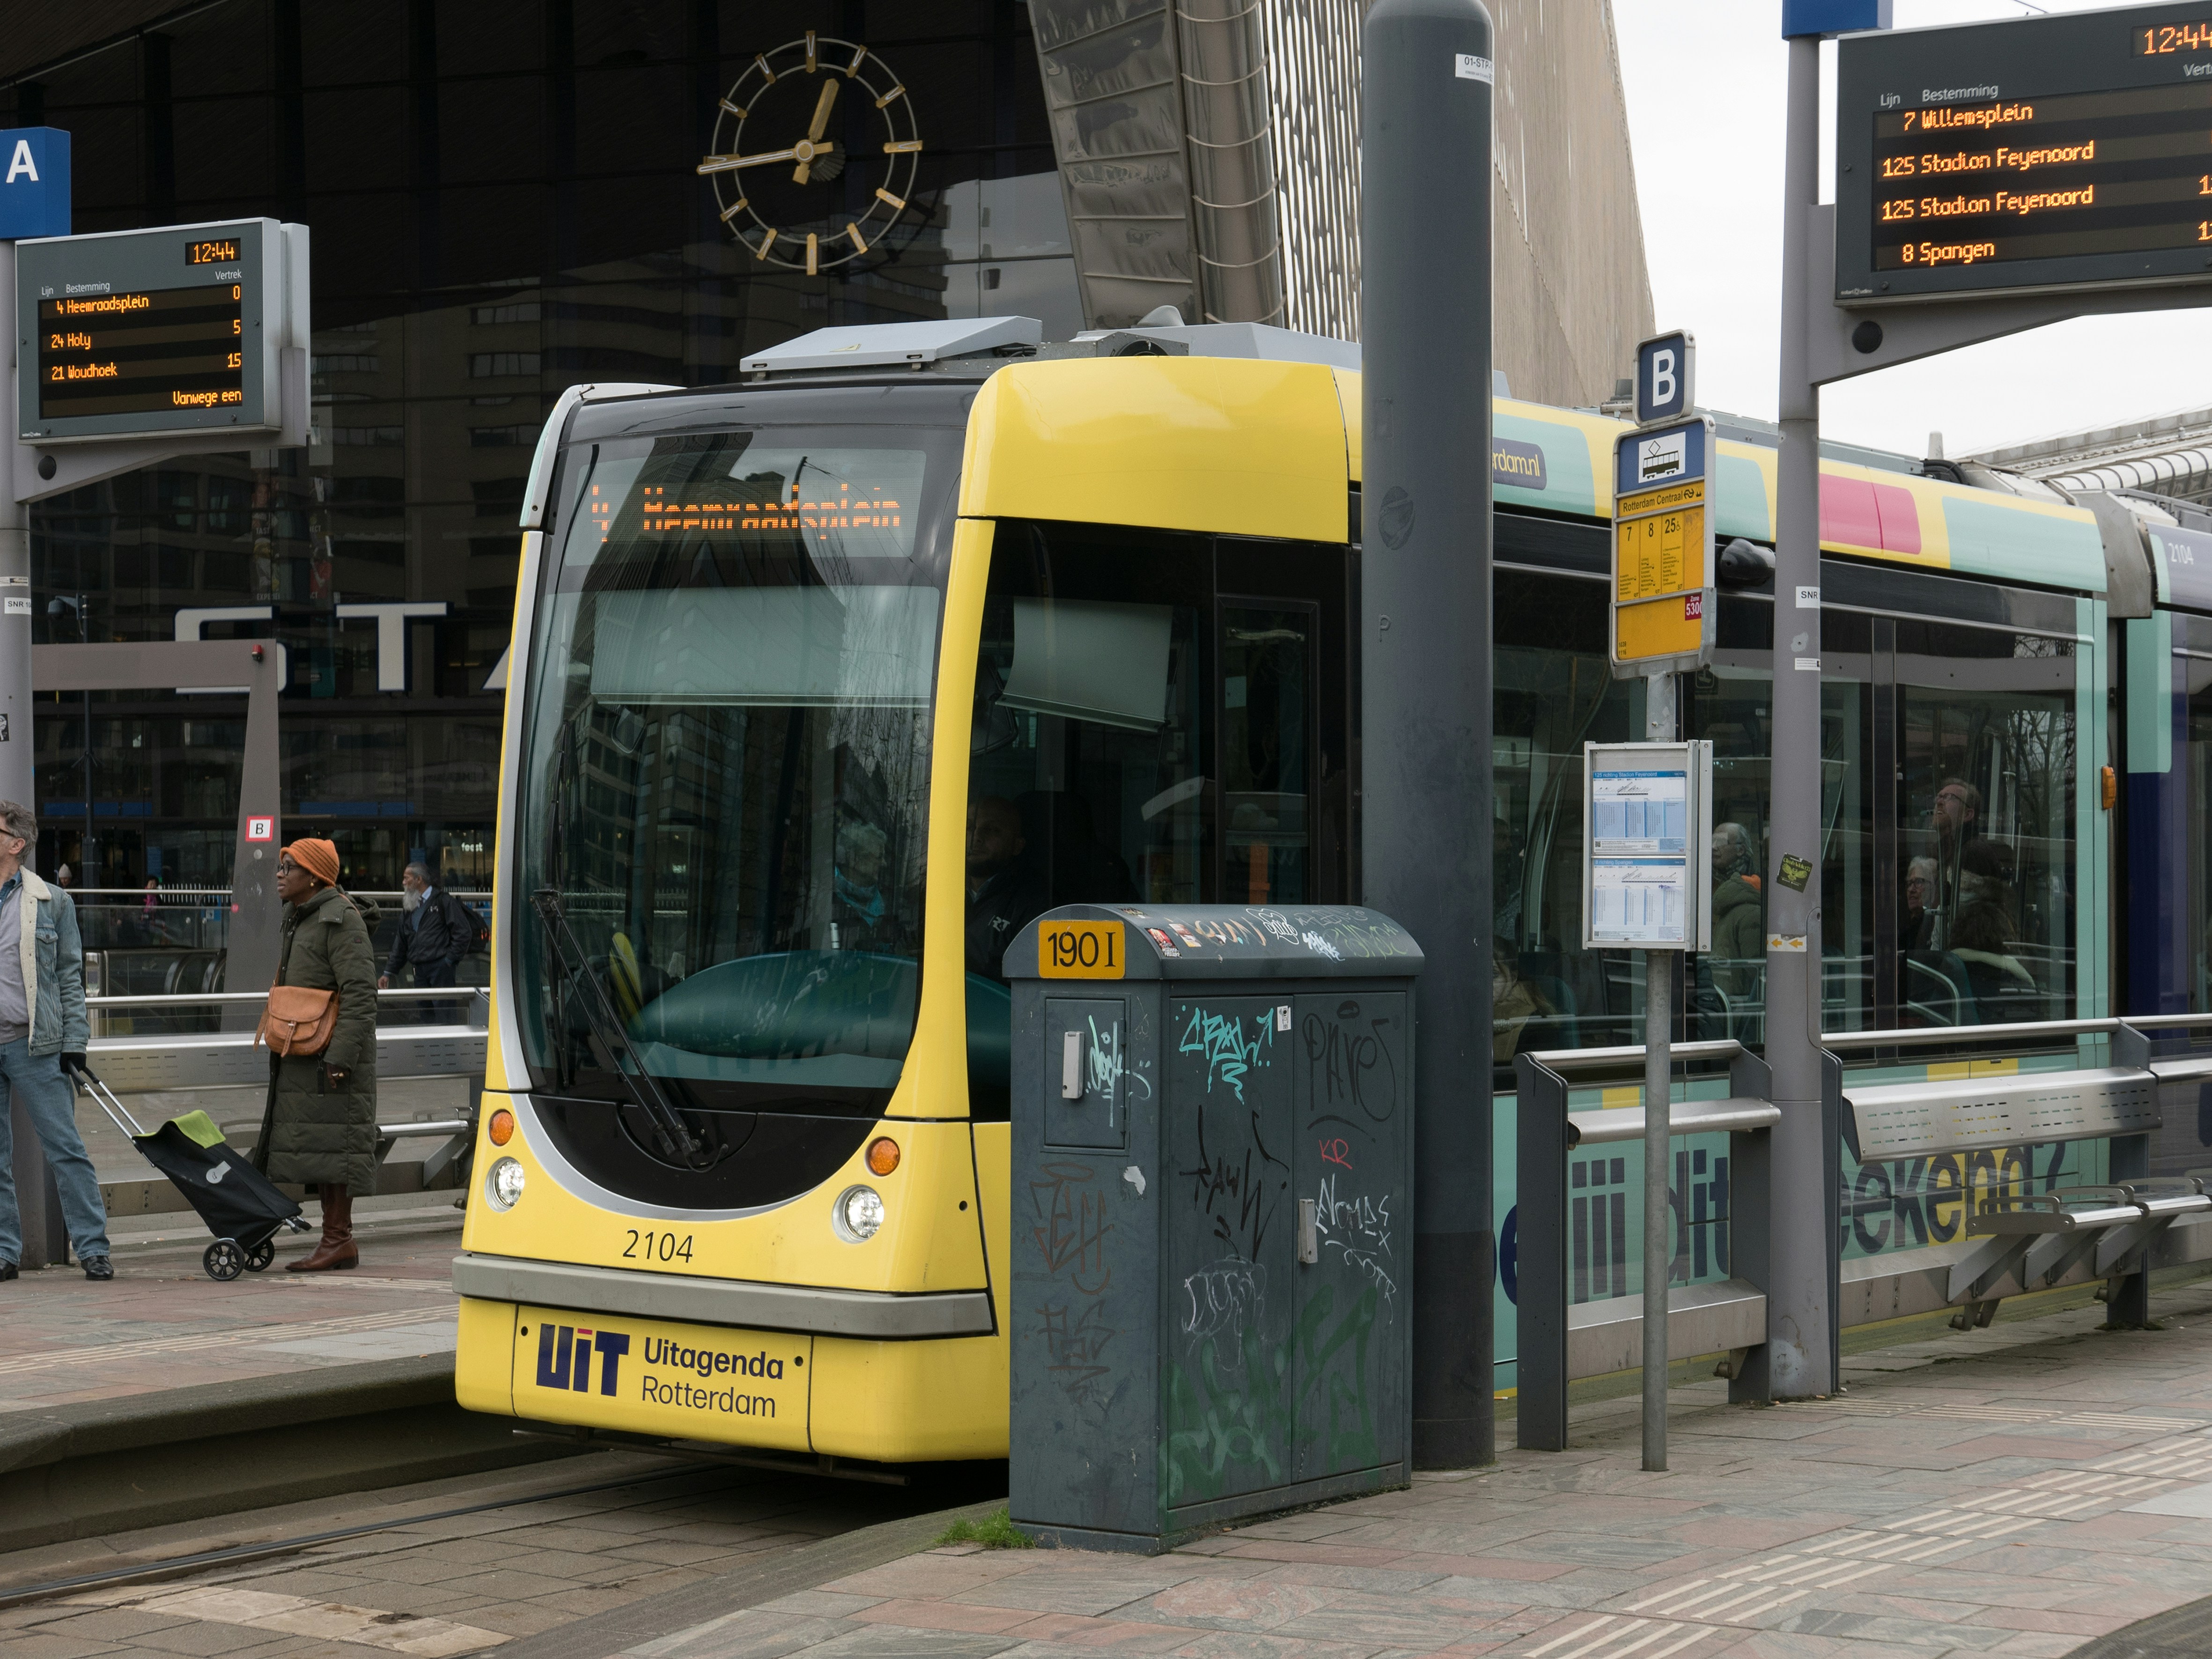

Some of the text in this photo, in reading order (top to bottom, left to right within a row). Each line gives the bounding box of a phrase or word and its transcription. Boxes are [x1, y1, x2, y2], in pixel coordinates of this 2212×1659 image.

[2144, 23, 2212, 55] 12:44
[1880, 84, 1998, 108] Lijn Bestemming
[1904, 104, 2033, 131] 7 Willemsplein
[6, 140, 39, 184] A
[1883, 140, 2094, 177] 125 Stadion Feyenoord
[1882, 184, 2094, 221] 125 Stadion Feyenoord
[193, 242, 235, 264] 12:44
[1902, 241, 1995, 266] 8 Spangen
[215, 269, 242, 280] Vertrek
[41, 281, 110, 296] Lijn Bestemming
[233, 286, 241, 300] 0
[57, 295, 149, 314] 4 Heemraadsplein
[233, 320, 241, 335] 5
[52, 333, 91, 349] 24 Holy
[52, 362, 118, 380] 21 Woudhoek
[228, 354, 242, 368] 15
[1652, 348, 1677, 407] B
[173, 391, 242, 406] Vanwege een
[1493, 448, 1541, 477] rdam.nl
[1623, 490, 1683, 512] Rotterdam Centraal
[1627, 526, 1632, 541] 7
[1648, 522, 1654, 538] 8
[1665, 517, 1676, 534] 25
[2168, 542, 2194, 565] 2104
[1801, 590, 1818, 600] SNR
[175, 602, 510, 693] ST
[256, 823, 264, 834] B
[622, 1229, 694, 1263] 2104
[644, 1337, 784, 1379] Uitagenda
[642, 1375, 776, 1418] Rotterdam
